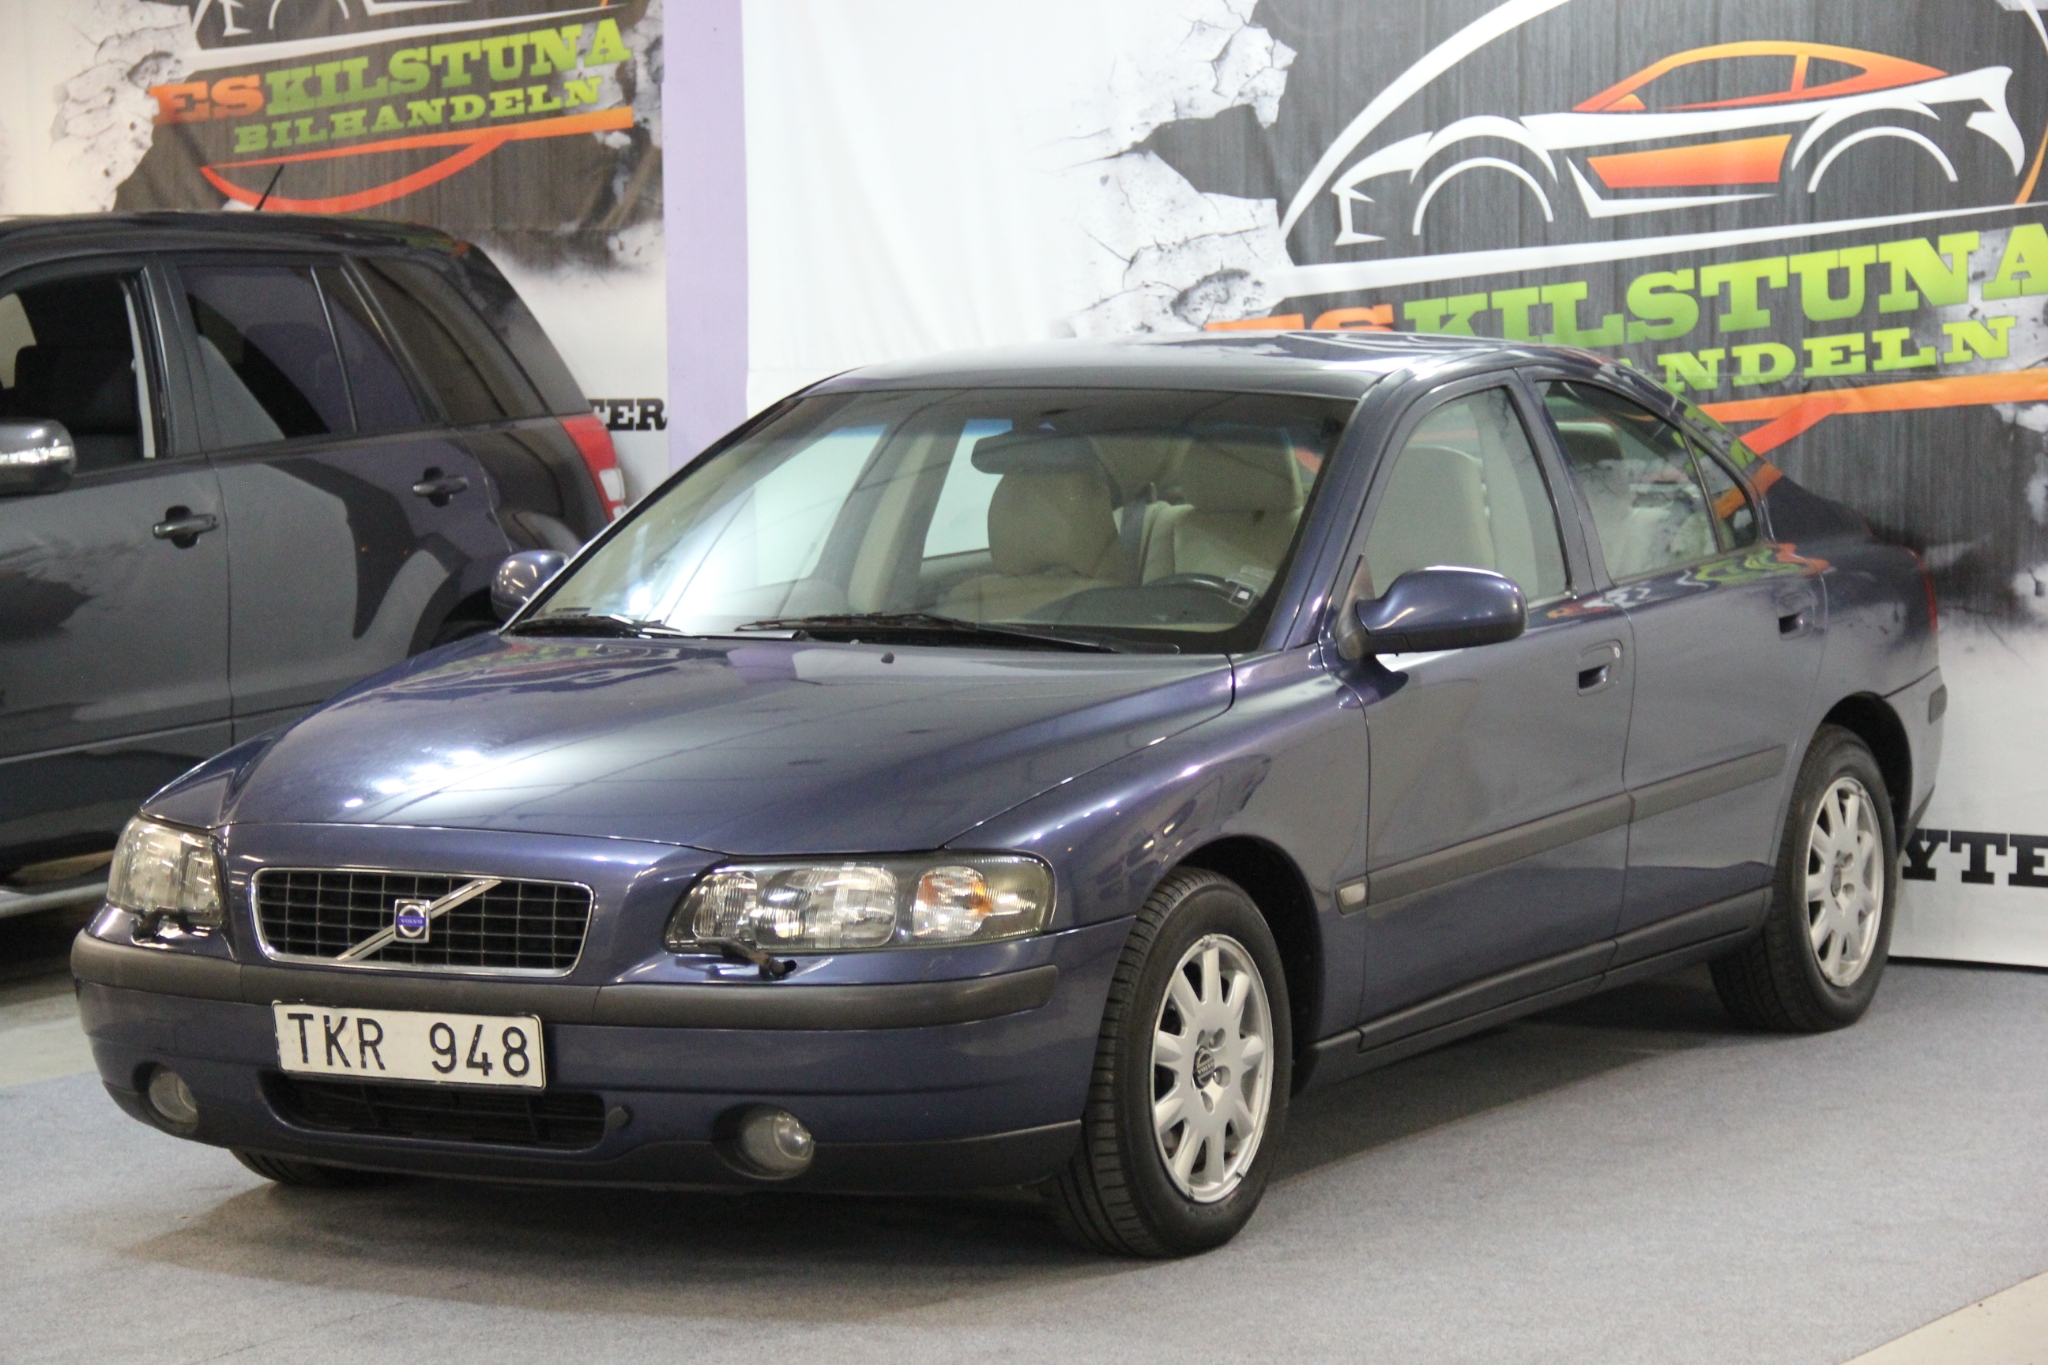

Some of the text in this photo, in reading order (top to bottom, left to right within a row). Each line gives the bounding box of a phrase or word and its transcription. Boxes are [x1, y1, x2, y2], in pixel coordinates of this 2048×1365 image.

[149, 18, 631, 125] ESKILSTUNA
[233, 76, 601, 153] BILHANDELN
[1205, 222, 2048, 348] KILSTUNA
[287, 1012, 530, 1078] TKR 948
